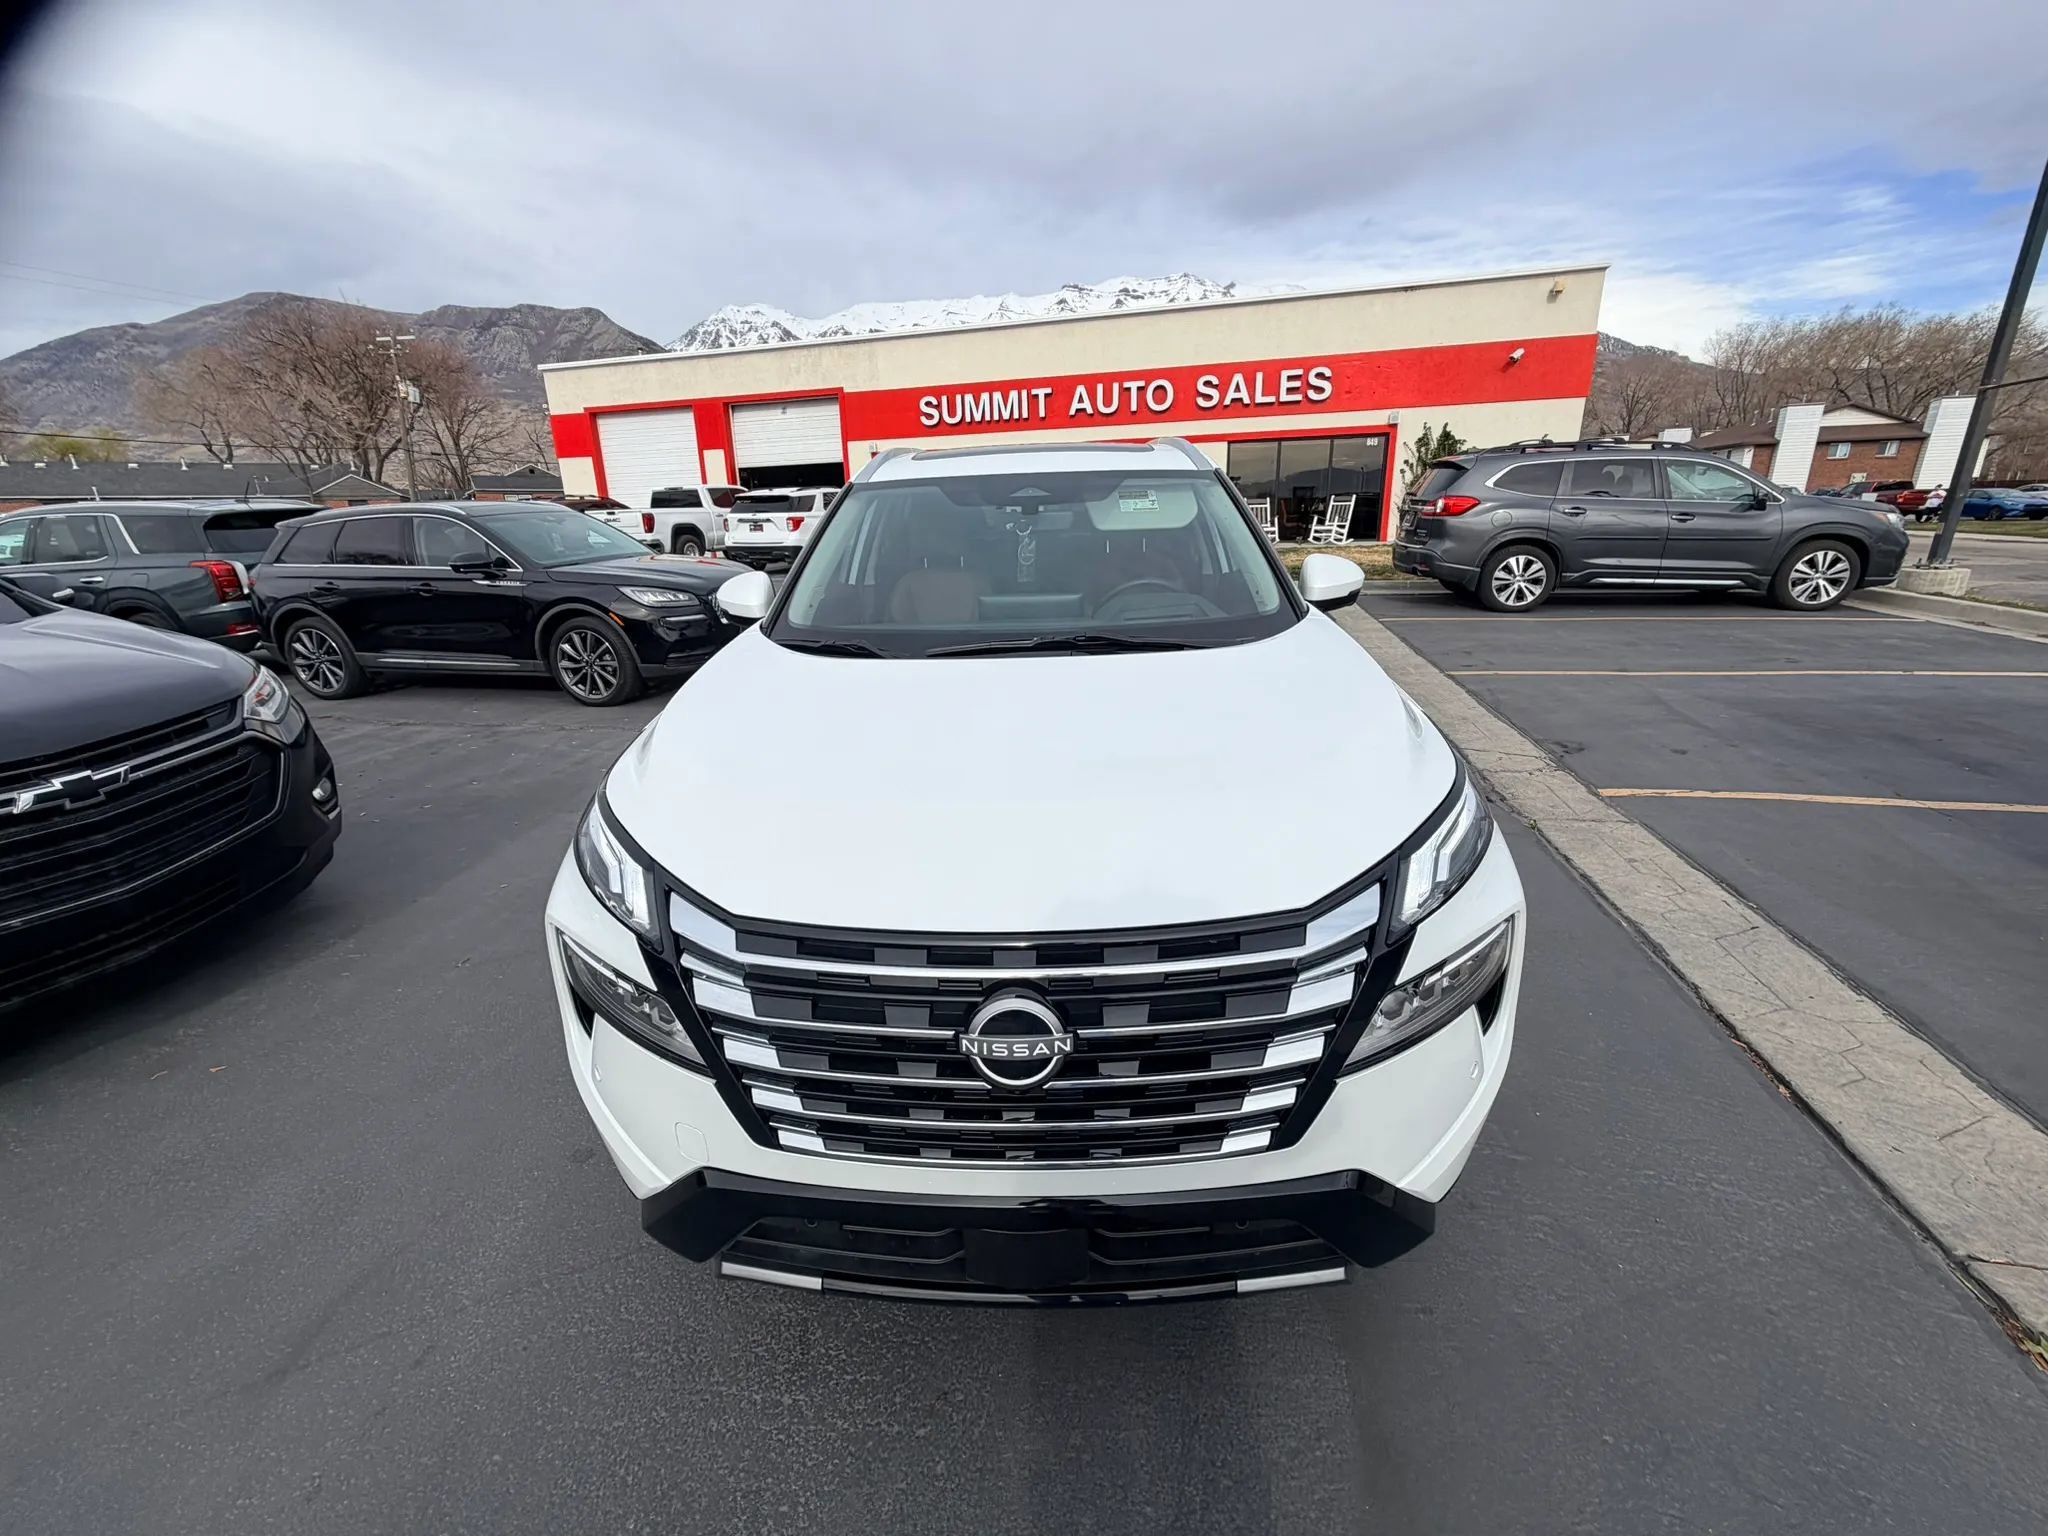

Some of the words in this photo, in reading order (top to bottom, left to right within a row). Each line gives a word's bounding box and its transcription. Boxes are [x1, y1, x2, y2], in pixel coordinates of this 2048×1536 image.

[919, 387, 1053, 426] SUMMIT
[1069, 379, 1174, 416] AUTO
[1195, 366, 1333, 408] SALES
[961, 1038, 1071, 1056] NISSAN
